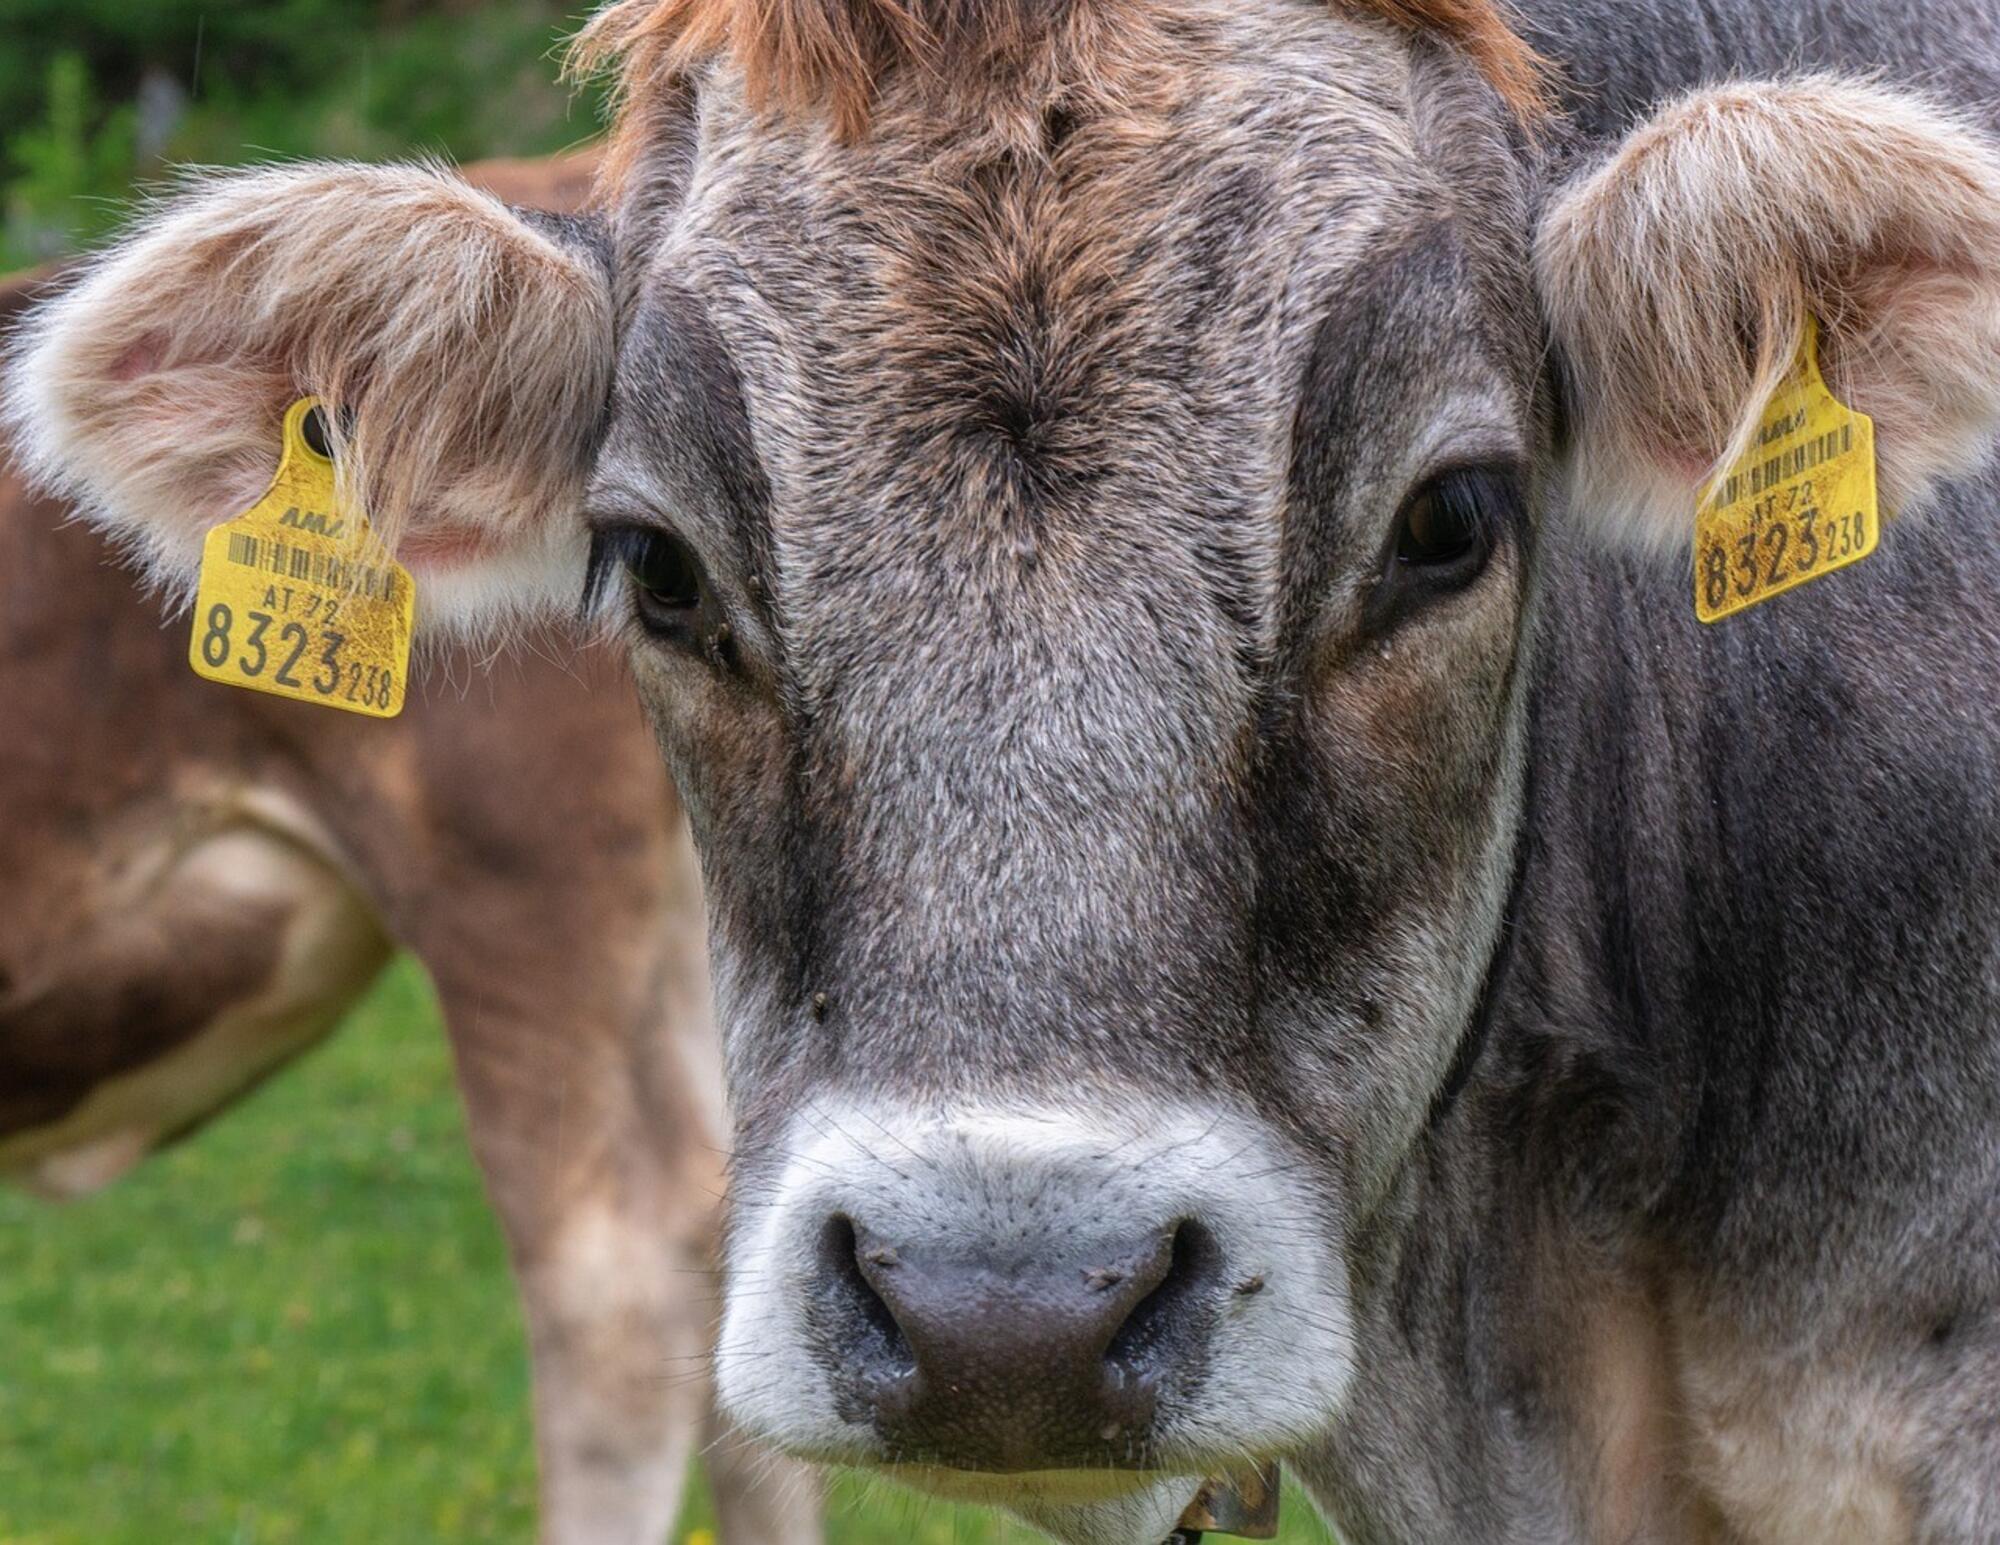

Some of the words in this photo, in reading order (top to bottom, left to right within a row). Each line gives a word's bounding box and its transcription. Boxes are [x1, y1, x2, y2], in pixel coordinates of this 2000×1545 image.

[1788, 481, 1812, 511] 72
[1704, 507, 1818, 609] 8323
[1826, 511, 1864, 562] 238
[262, 585, 295, 613] AT
[305, 594, 339, 626] 72
[202, 603, 345, 694] 8323
[346, 662, 391, 710] 238
